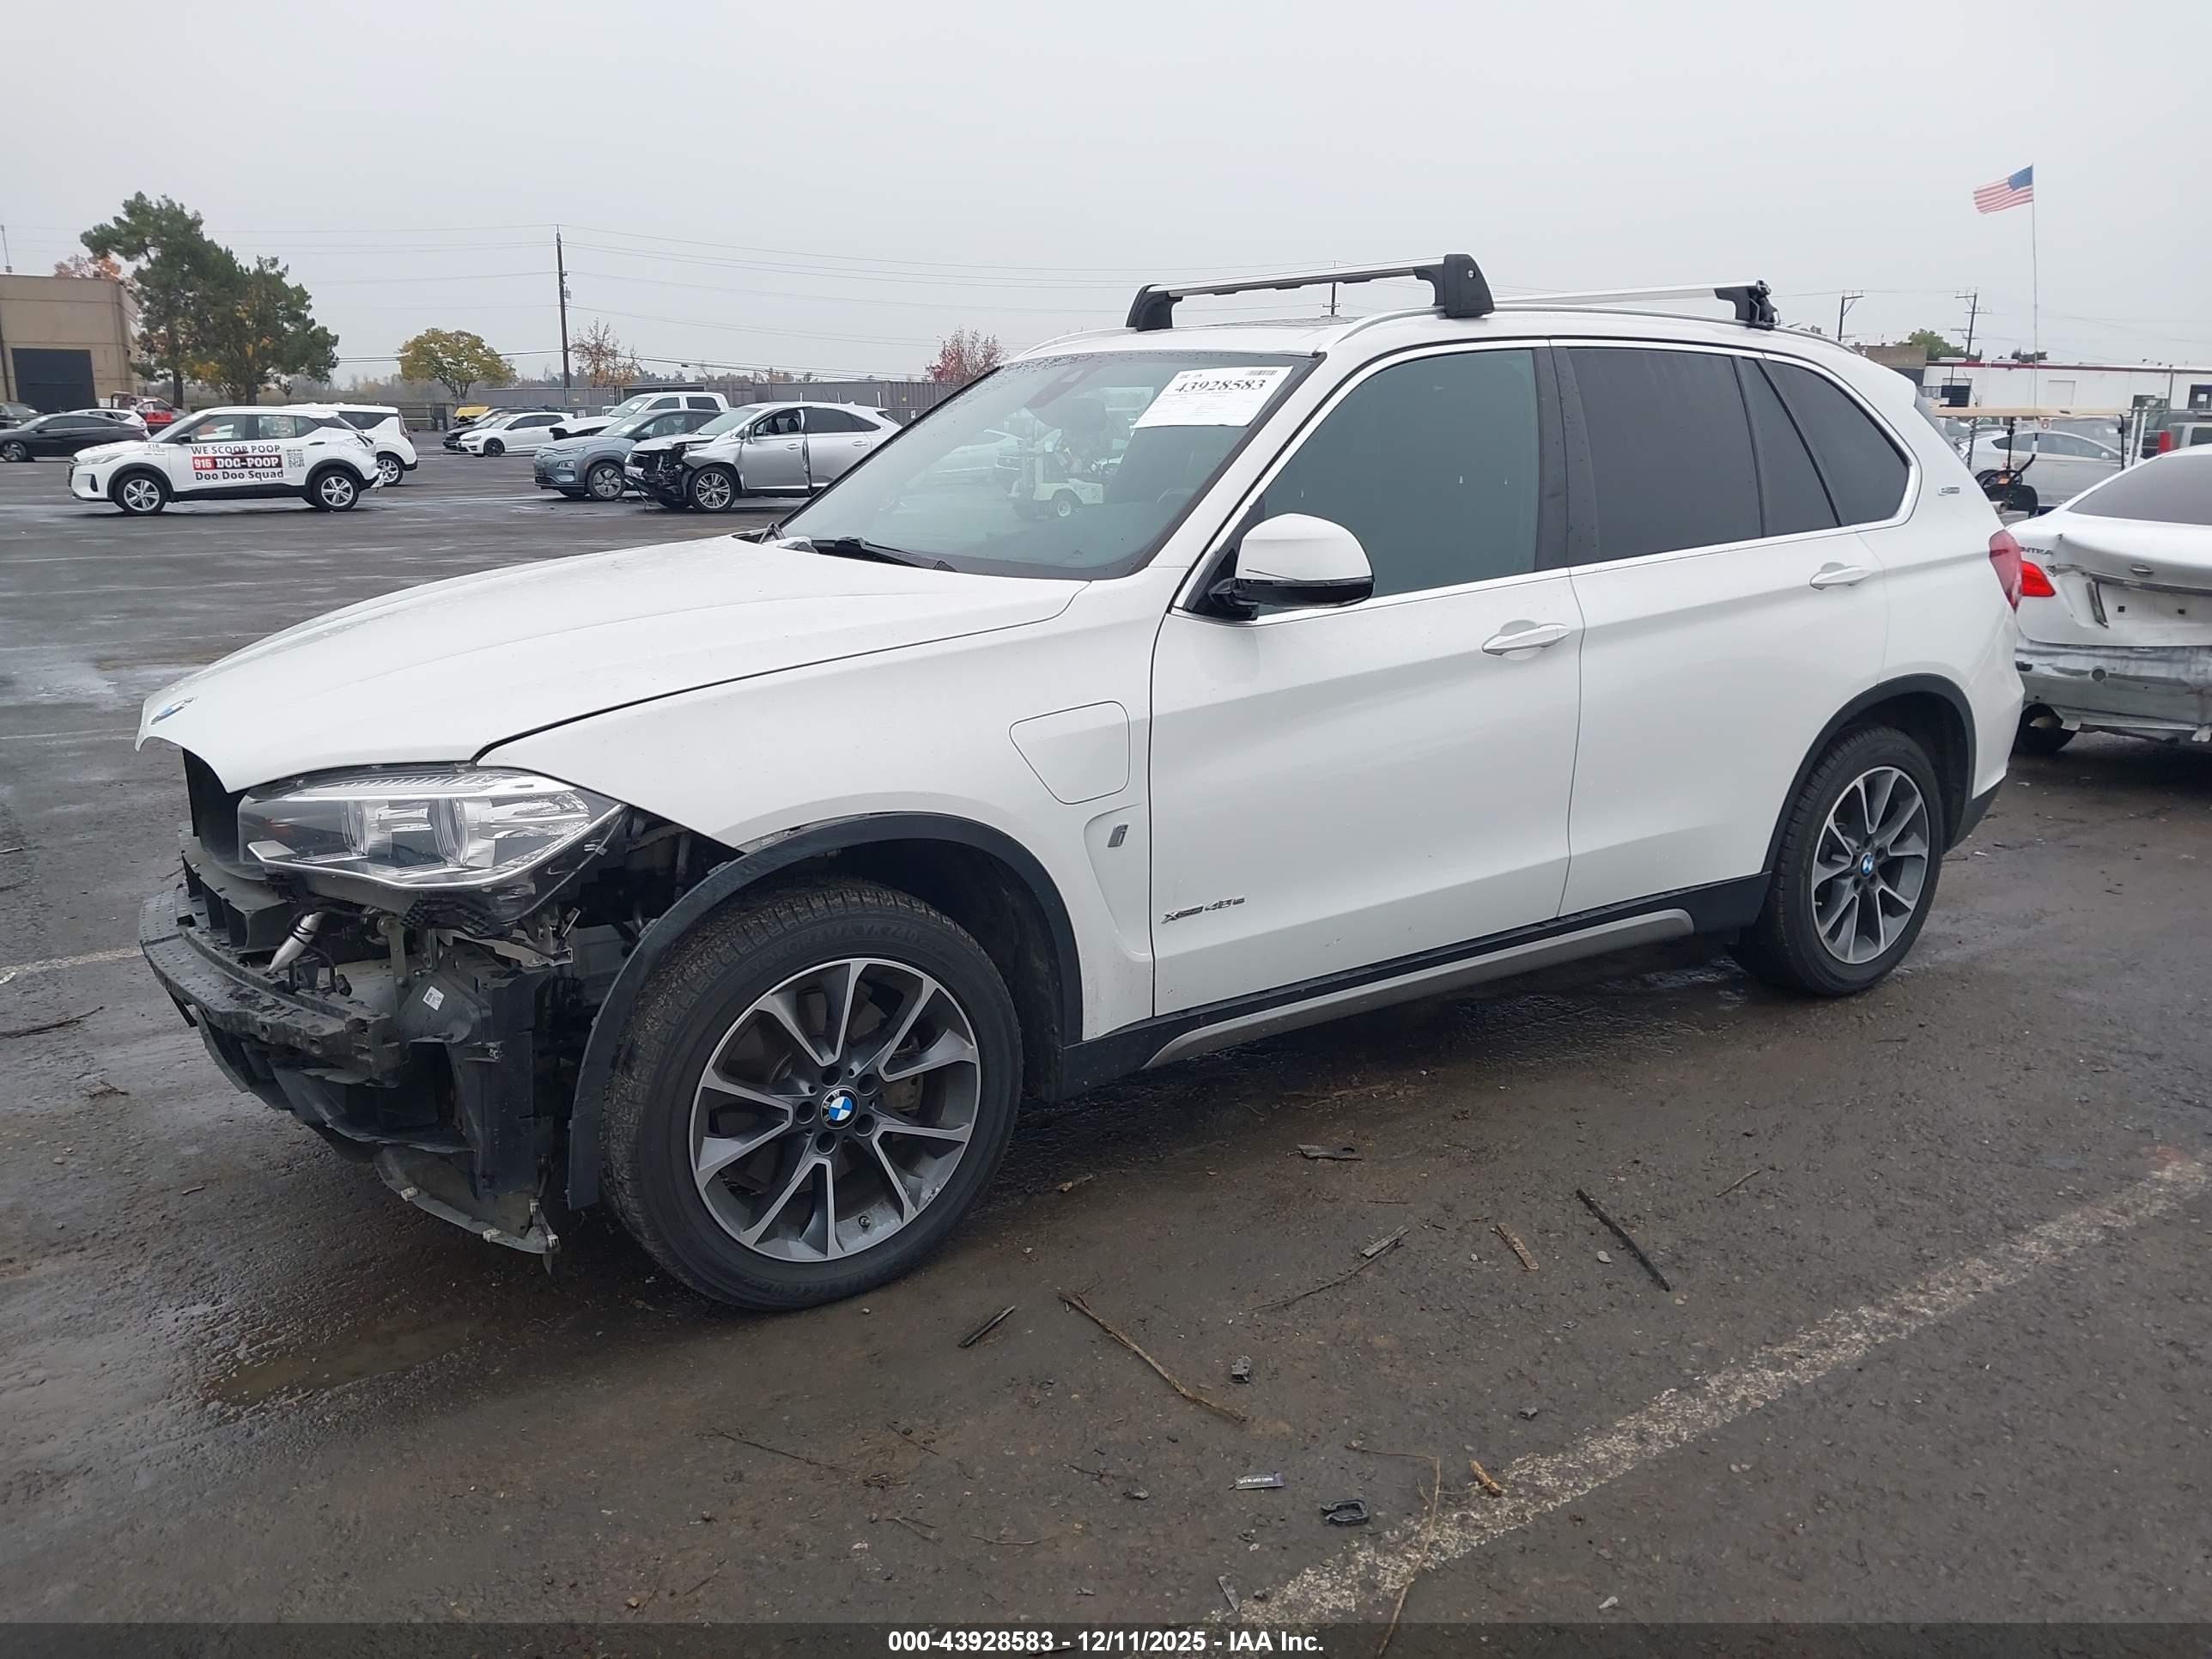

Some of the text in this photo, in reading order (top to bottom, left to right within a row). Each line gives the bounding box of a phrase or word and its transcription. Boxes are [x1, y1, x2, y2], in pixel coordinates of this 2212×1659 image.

[1175, 380, 1266, 392] 43928583
[211, 446, 248, 454] SCOOP
[252, 445, 281, 453] POOP
[194, 457, 279, 469] 916 DOG-POOP
[195, 469, 284, 481] Doo Doo Squad
